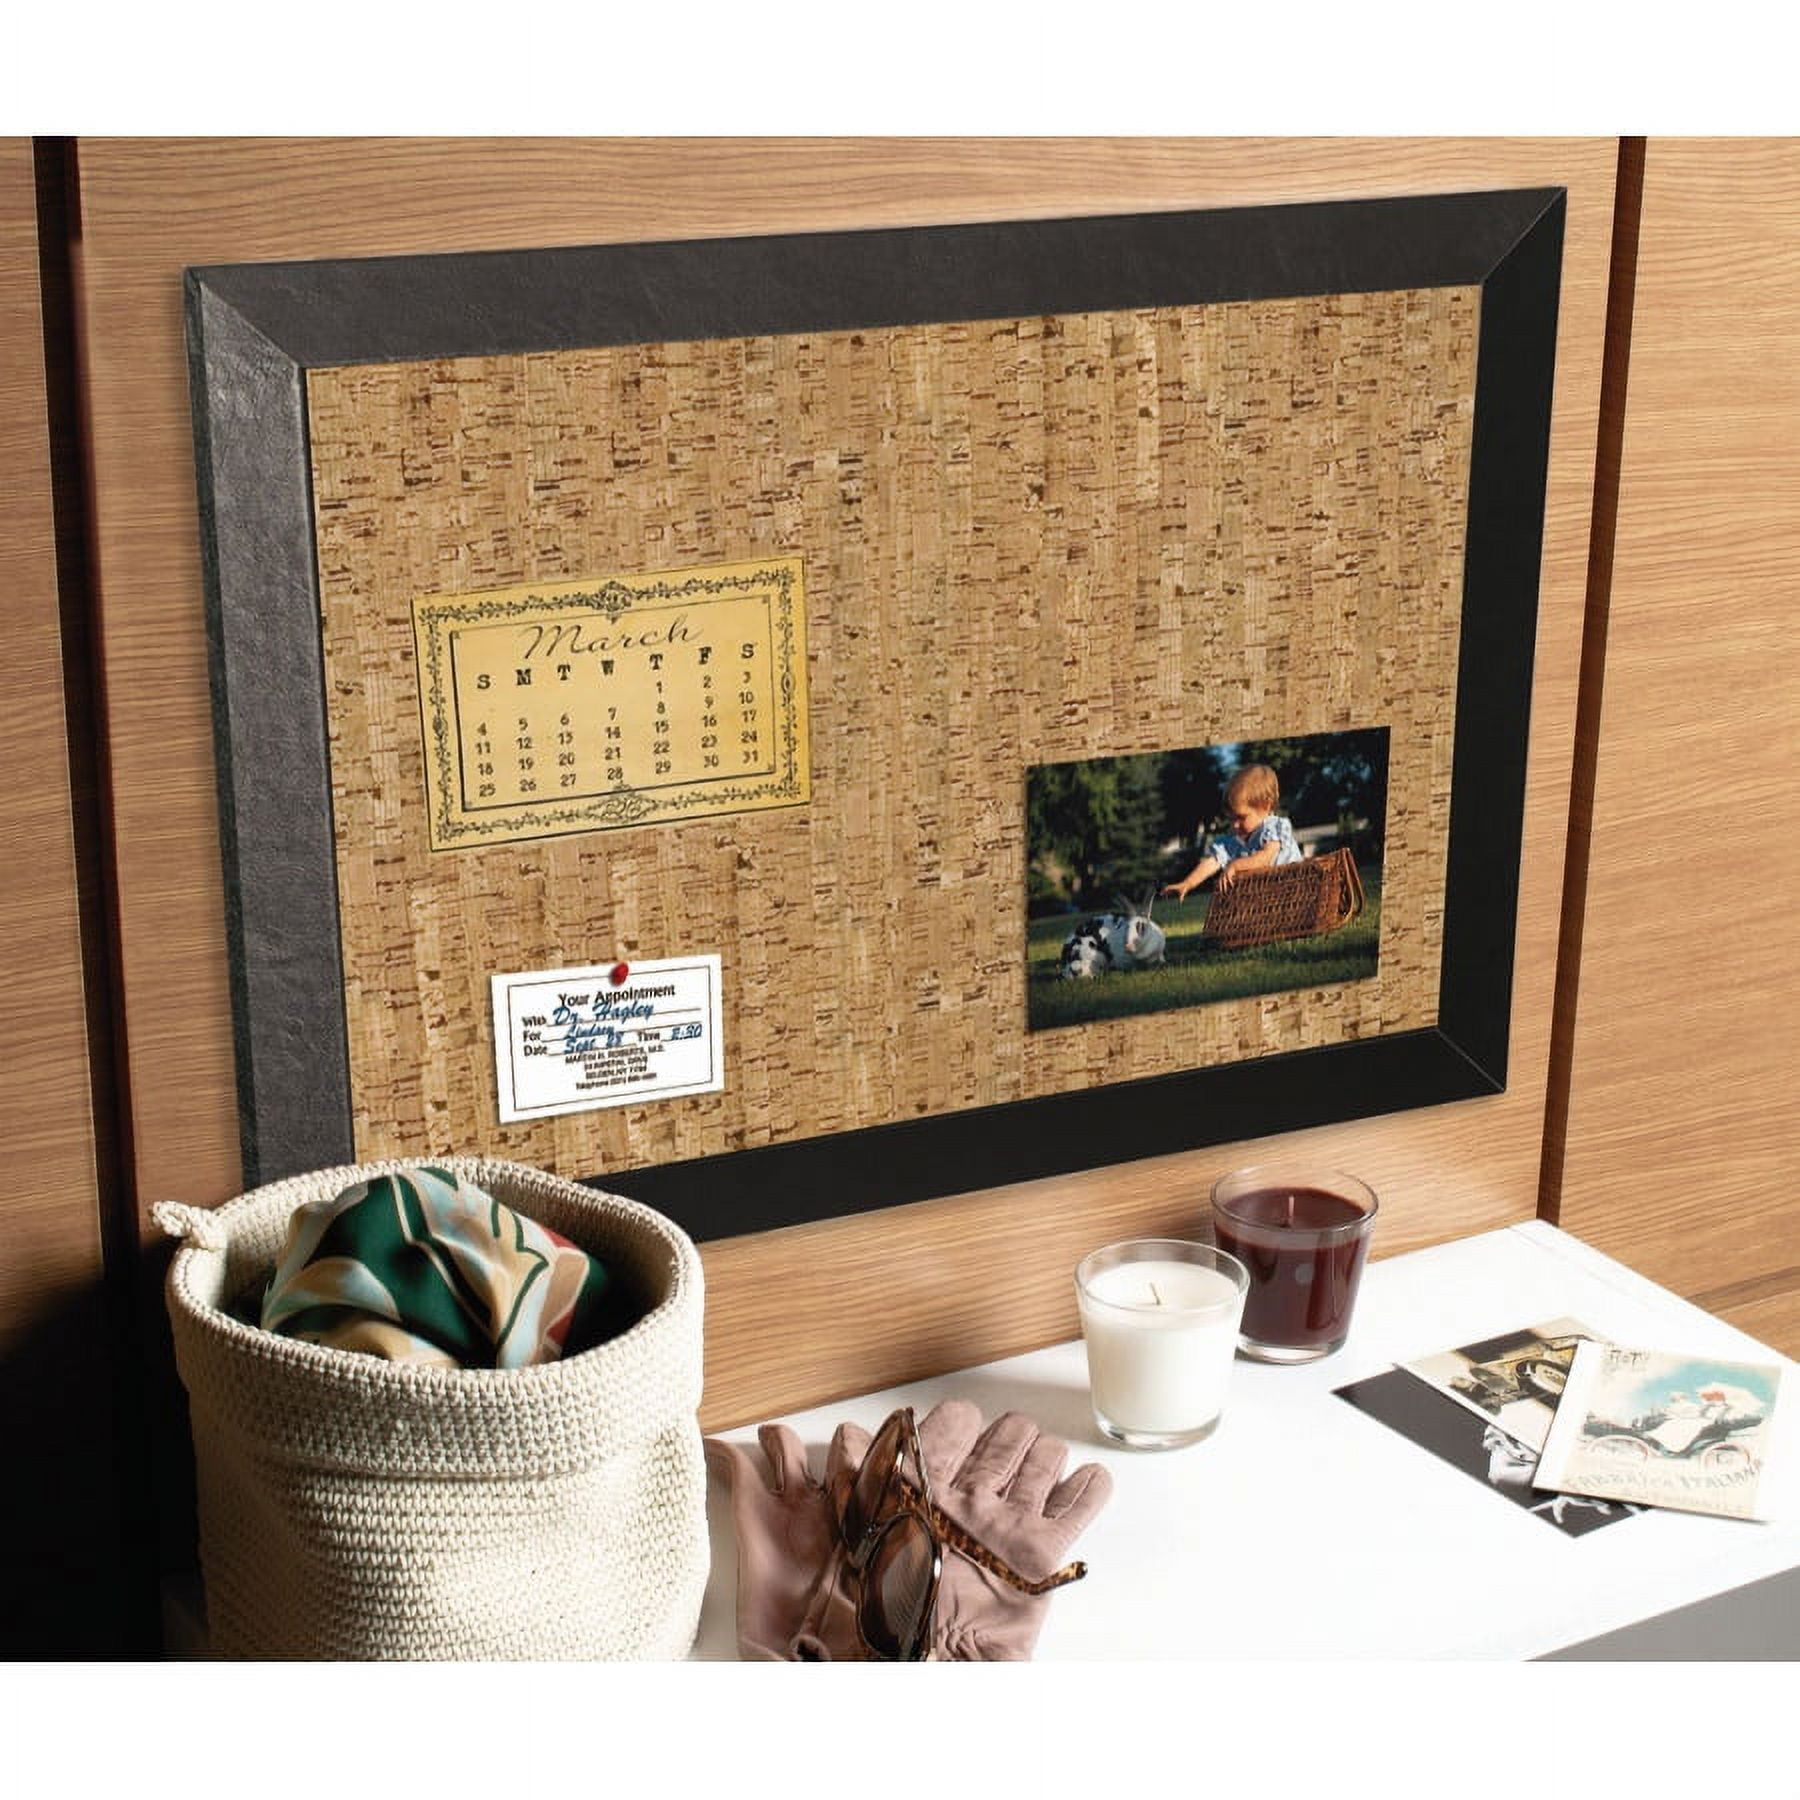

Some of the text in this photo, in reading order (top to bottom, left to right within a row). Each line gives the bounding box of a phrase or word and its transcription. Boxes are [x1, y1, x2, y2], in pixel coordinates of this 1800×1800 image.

[518, 614, 704, 659] March
[477, 643, 755, 690] S M T W T F S
[656, 671, 751, 694] 1 2 3
[475, 741, 491, 755] 11
[516, 736, 533, 750] 12
[605, 726, 622, 739] 14
[655, 720, 670, 733] 15
[701, 715, 718, 728] 16
[742, 709, 756, 723] 17
[477, 691, 755, 736] 4 5 6 7 8 9 10
[477, 730, 758, 776] 18 19 20 21 22 23 24
[479, 749, 759, 797] 25 26 27 28 29 30 31
[558, 984, 676, 1007] Your Appointment
[522, 1029, 542, 1042] For
[523, 1044, 548, 1058] Date
